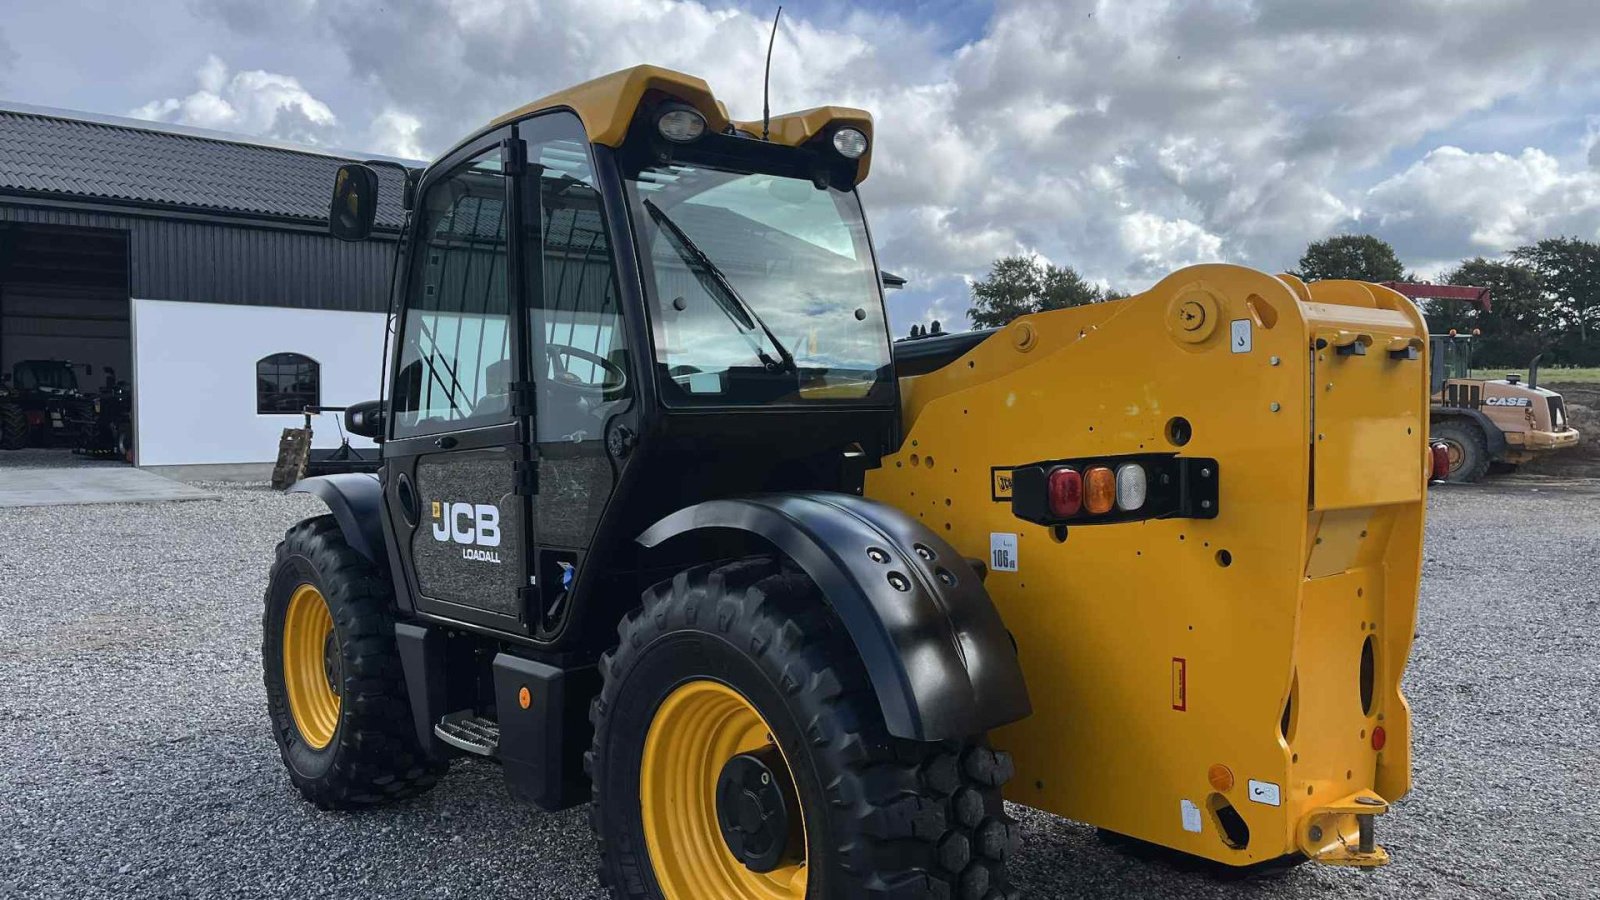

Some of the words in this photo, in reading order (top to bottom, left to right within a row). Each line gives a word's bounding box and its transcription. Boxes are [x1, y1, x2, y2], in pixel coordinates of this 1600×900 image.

[1485, 396, 1529, 406] CASE
[432, 502, 501, 547] JCB
[462, 548, 501, 563] LOADALL
[992, 549, 1009, 568] 106
